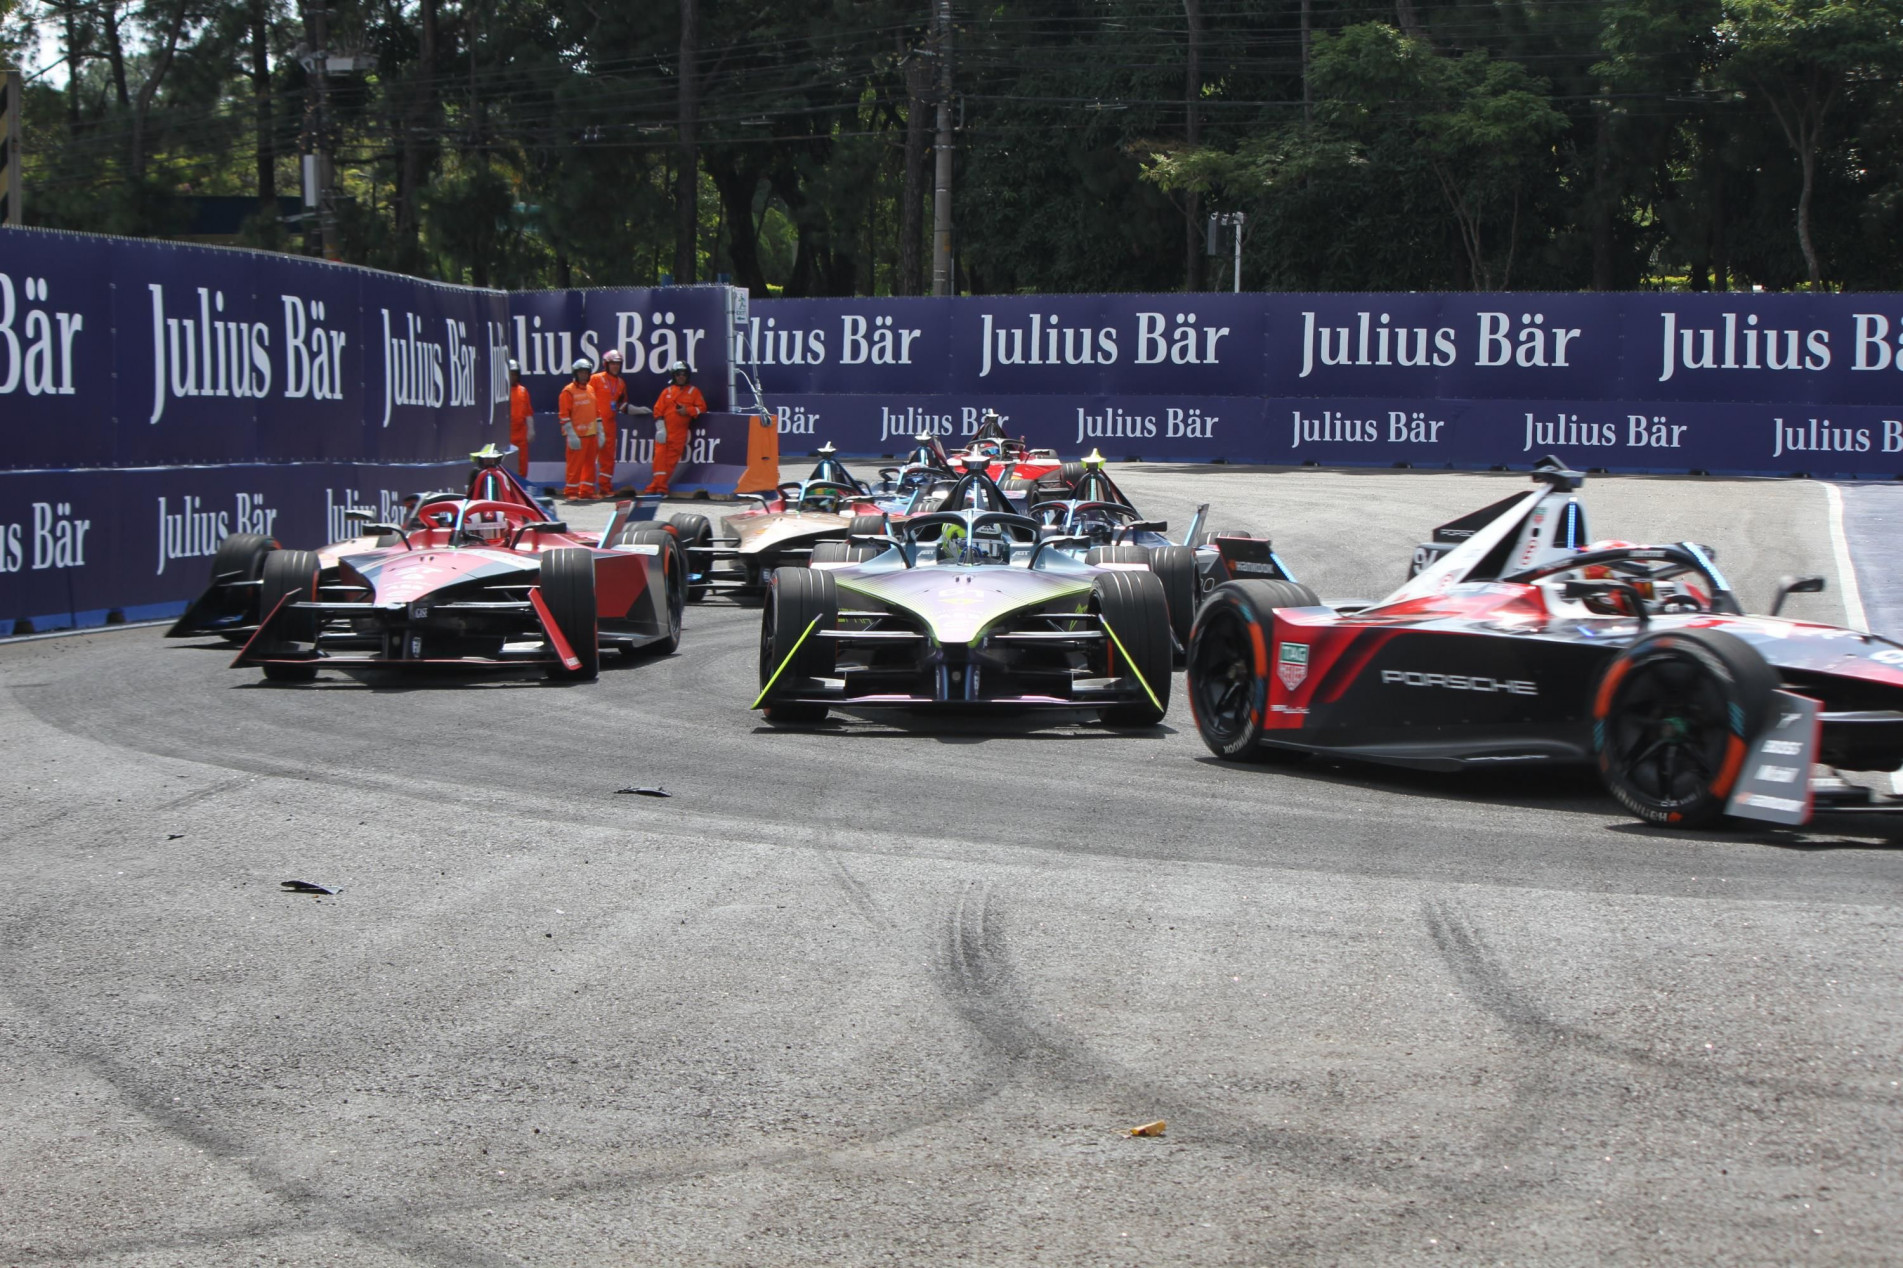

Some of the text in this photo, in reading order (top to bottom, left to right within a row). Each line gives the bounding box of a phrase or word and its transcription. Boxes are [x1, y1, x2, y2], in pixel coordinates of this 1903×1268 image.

[149, 284, 346, 424] Julius Bär
[513, 312, 705, 376] lius Bär
[840, 315, 921, 365] Bär
[980, 312, 1230, 378] Julius Bär
[1299, 311, 1581, 378] Julius Bär
[1659, 312, 1903, 382] Julius B
[382, 309, 476, 427] Julius Bär
[776, 406, 820, 435] Bär
[881, 407, 953, 441] Julius
[1076, 407, 1219, 444] Julius Bär
[1292, 411, 1444, 448] Julius Bär
[1523, 413, 1687, 452] Julius Bär
[1773, 418, 1871, 458] Julius
[615, 428, 655, 464] liu
[32, 502, 90, 570] Bär
[157, 496, 229, 576] Julius
[1380, 670, 1539, 695] PORSCHE
